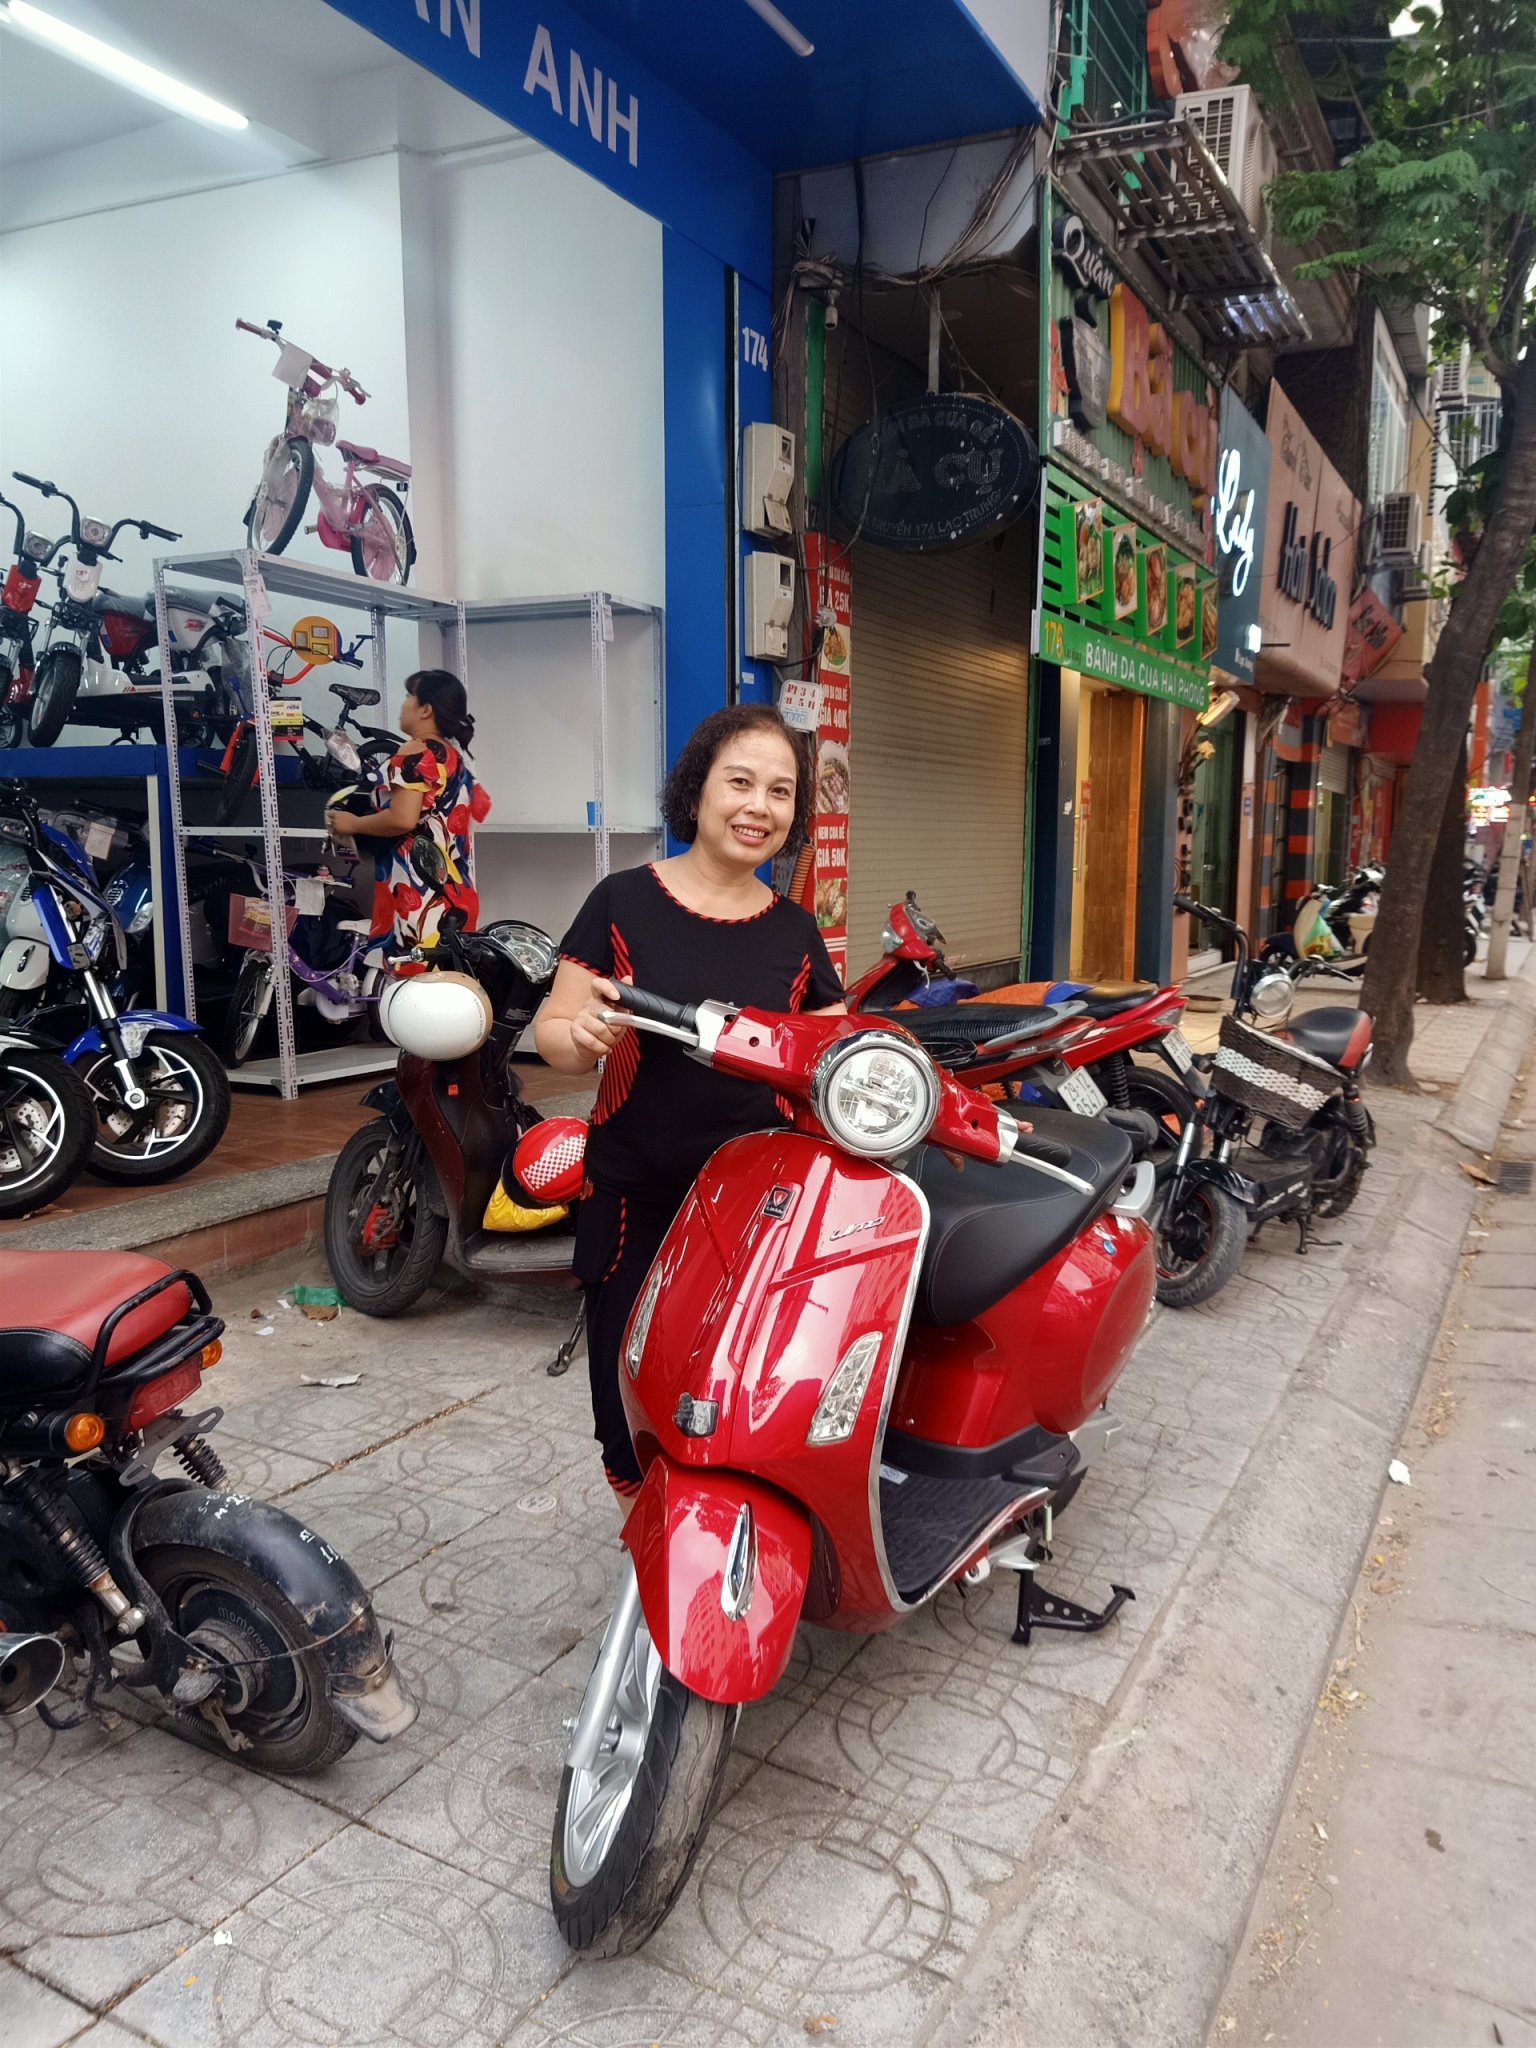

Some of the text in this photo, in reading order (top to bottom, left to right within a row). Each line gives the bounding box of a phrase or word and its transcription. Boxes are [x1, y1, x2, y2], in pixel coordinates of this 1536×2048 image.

[523, 23, 639, 169] ANH
[742, 326, 769, 373] 174
[963, 487, 1002, 522] TRUNG
[834, 590, 850, 614] 25K
[1044, 619, 1065, 660] 176
[1086, 639, 1118, 677] BÁNH
[1120, 656, 1136, 683] ĐA
[1139, 662, 1159, 690] CUA
[833, 707, 848, 729] 40K
[816, 843, 846, 868] GIÁ 50K
